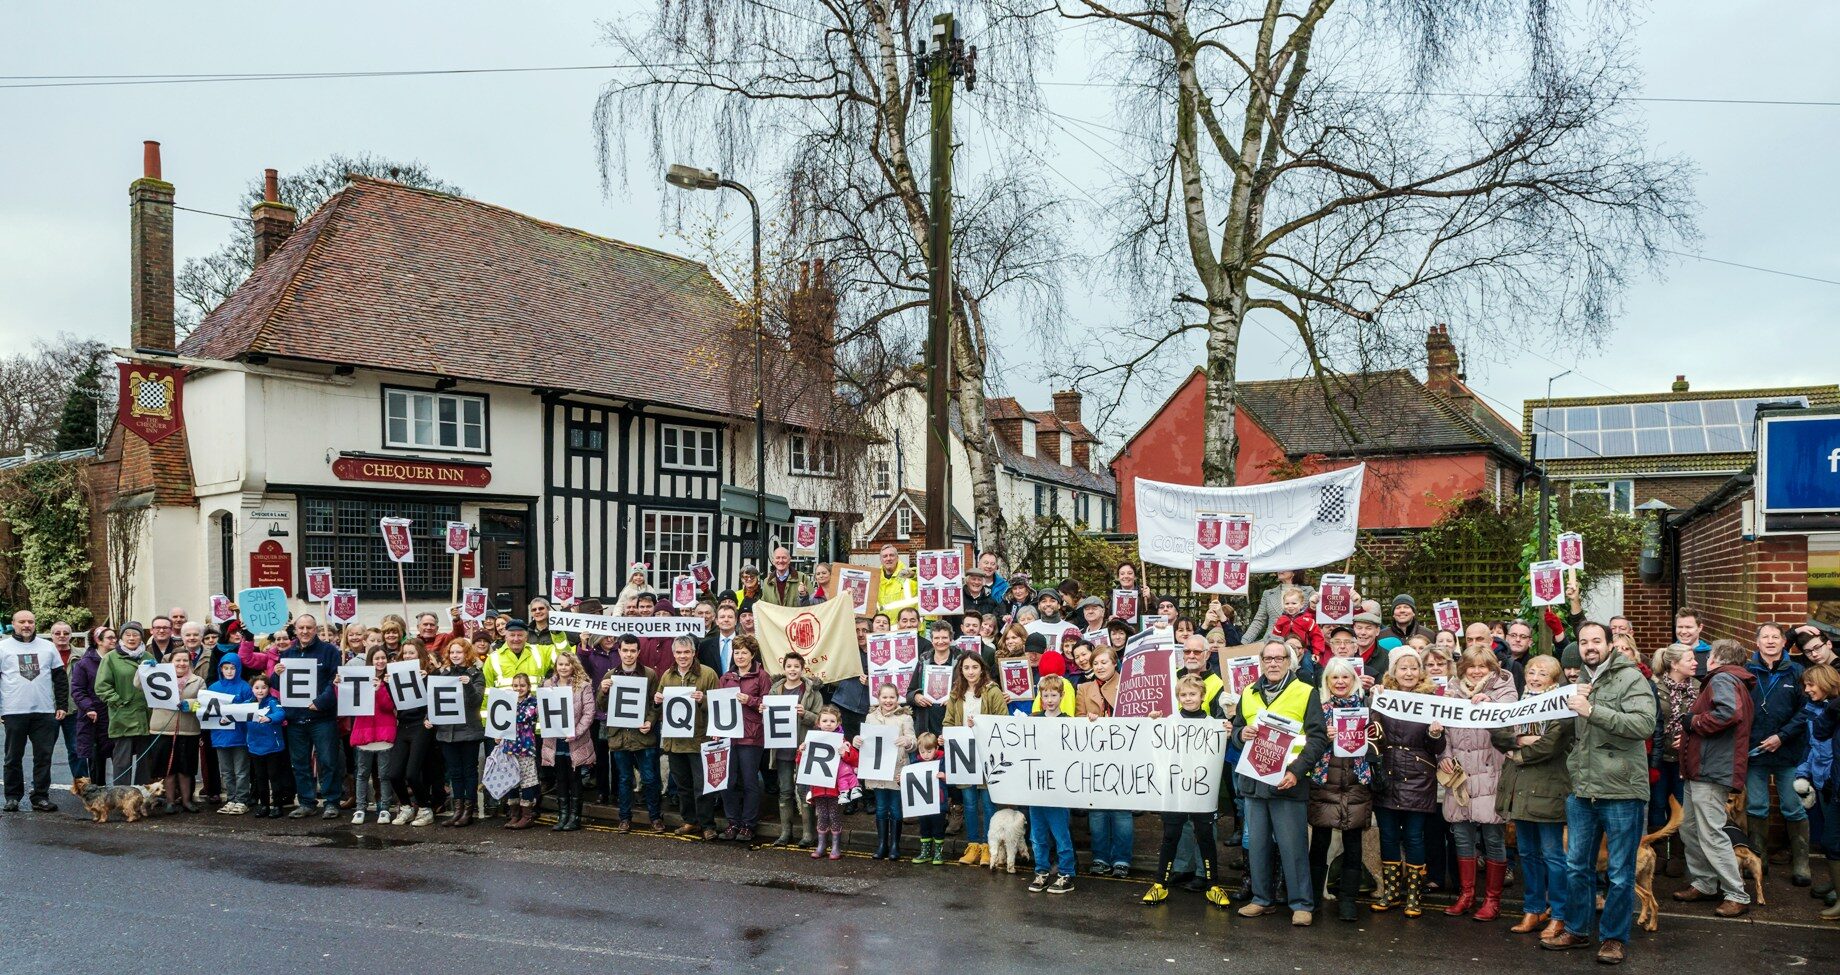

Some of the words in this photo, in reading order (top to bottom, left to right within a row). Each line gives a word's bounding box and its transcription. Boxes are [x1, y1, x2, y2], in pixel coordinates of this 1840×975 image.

[136, 421, 167, 429] CHEQUER
[363, 463, 434, 480] CHEQUER
[437, 468, 464, 481] INN
[1224, 572, 1246, 580] SAVE
[247, 590, 275, 602] SAVE
[253, 601, 277, 612] OUR
[250, 612, 280, 627] PUB
[549, 616, 581, 628] SAVE
[586, 619, 608, 631] THE
[611, 622, 671, 634] CHEQUER
[675, 622, 701, 632] INN
[1441, 618, 1460, 626] SAVE
[20, 663, 39, 672] SAVE
[1006, 678, 1028, 686] SAVE
[146, 671, 173, 701] S
[286, 669, 311, 698] E
[344, 676, 370, 706] T
[392, 670, 423, 701] H
[1119, 674, 1168, 693] COMMUNITY
[1119, 687, 1164, 705] COMES
[434, 686, 459, 716] E
[490, 699, 512, 731] C
[542, 697, 569, 729] H
[614, 686, 640, 719] E
[666, 696, 693, 731] Q
[712, 698, 738, 731] U
[1121, 700, 1159, 716] FIRST
[1376, 696, 1424, 716] SAVE
[1430, 703, 1464, 721] THE
[1469, 703, 1538, 723] CHEQUER
[1540, 694, 1570, 713] INN
[768, 705, 792, 739] E
[1338, 730, 1364, 741] SAVE
[873, 736, 883, 770] I
[987, 722, 1037, 750] ASH
[1061, 723, 1141, 753] RUGBY
[1151, 723, 1227, 755] SUPPORT
[1254, 737, 1287, 755] COMMUNITY
[1254, 745, 1281, 761] COMES
[803, 741, 836, 778] R
[948, 738, 977, 774] N
[1254, 754, 1278, 767] FIRST
[906, 770, 933, 807] N
[1064, 760, 1163, 796] CHEQUER
